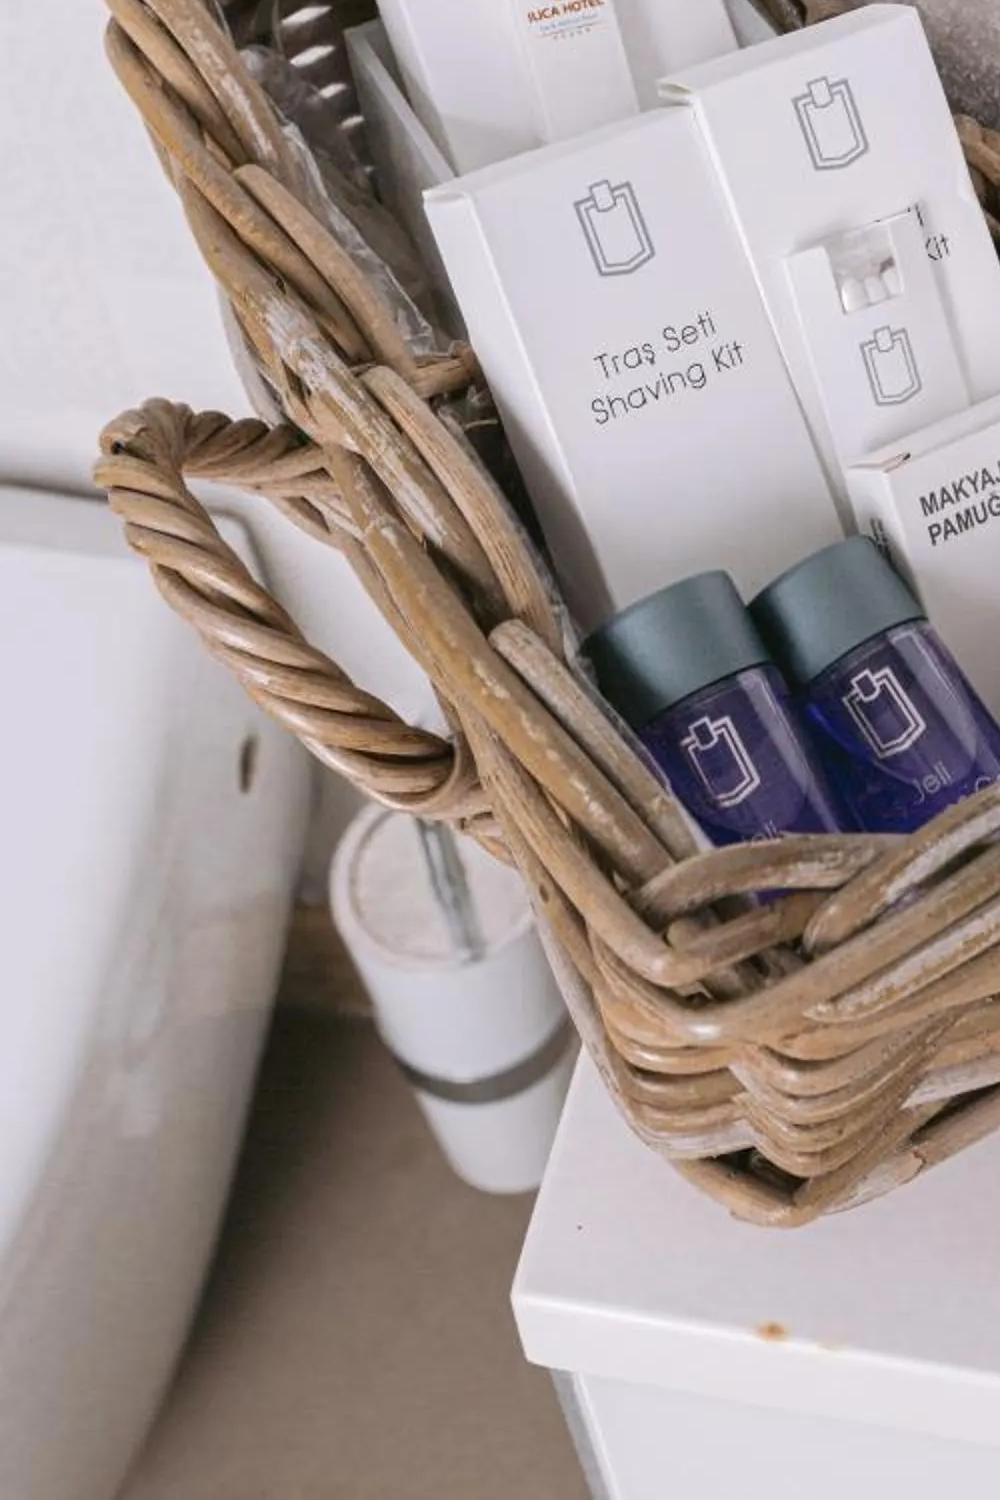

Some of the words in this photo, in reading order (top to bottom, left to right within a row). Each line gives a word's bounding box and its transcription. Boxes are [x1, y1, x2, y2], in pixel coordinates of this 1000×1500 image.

[591, 361, 707, 425] Shaving
[711, 341, 744, 373] Kit
[593, 343, 656, 380] Traş
[662, 311, 717, 352] Seti
